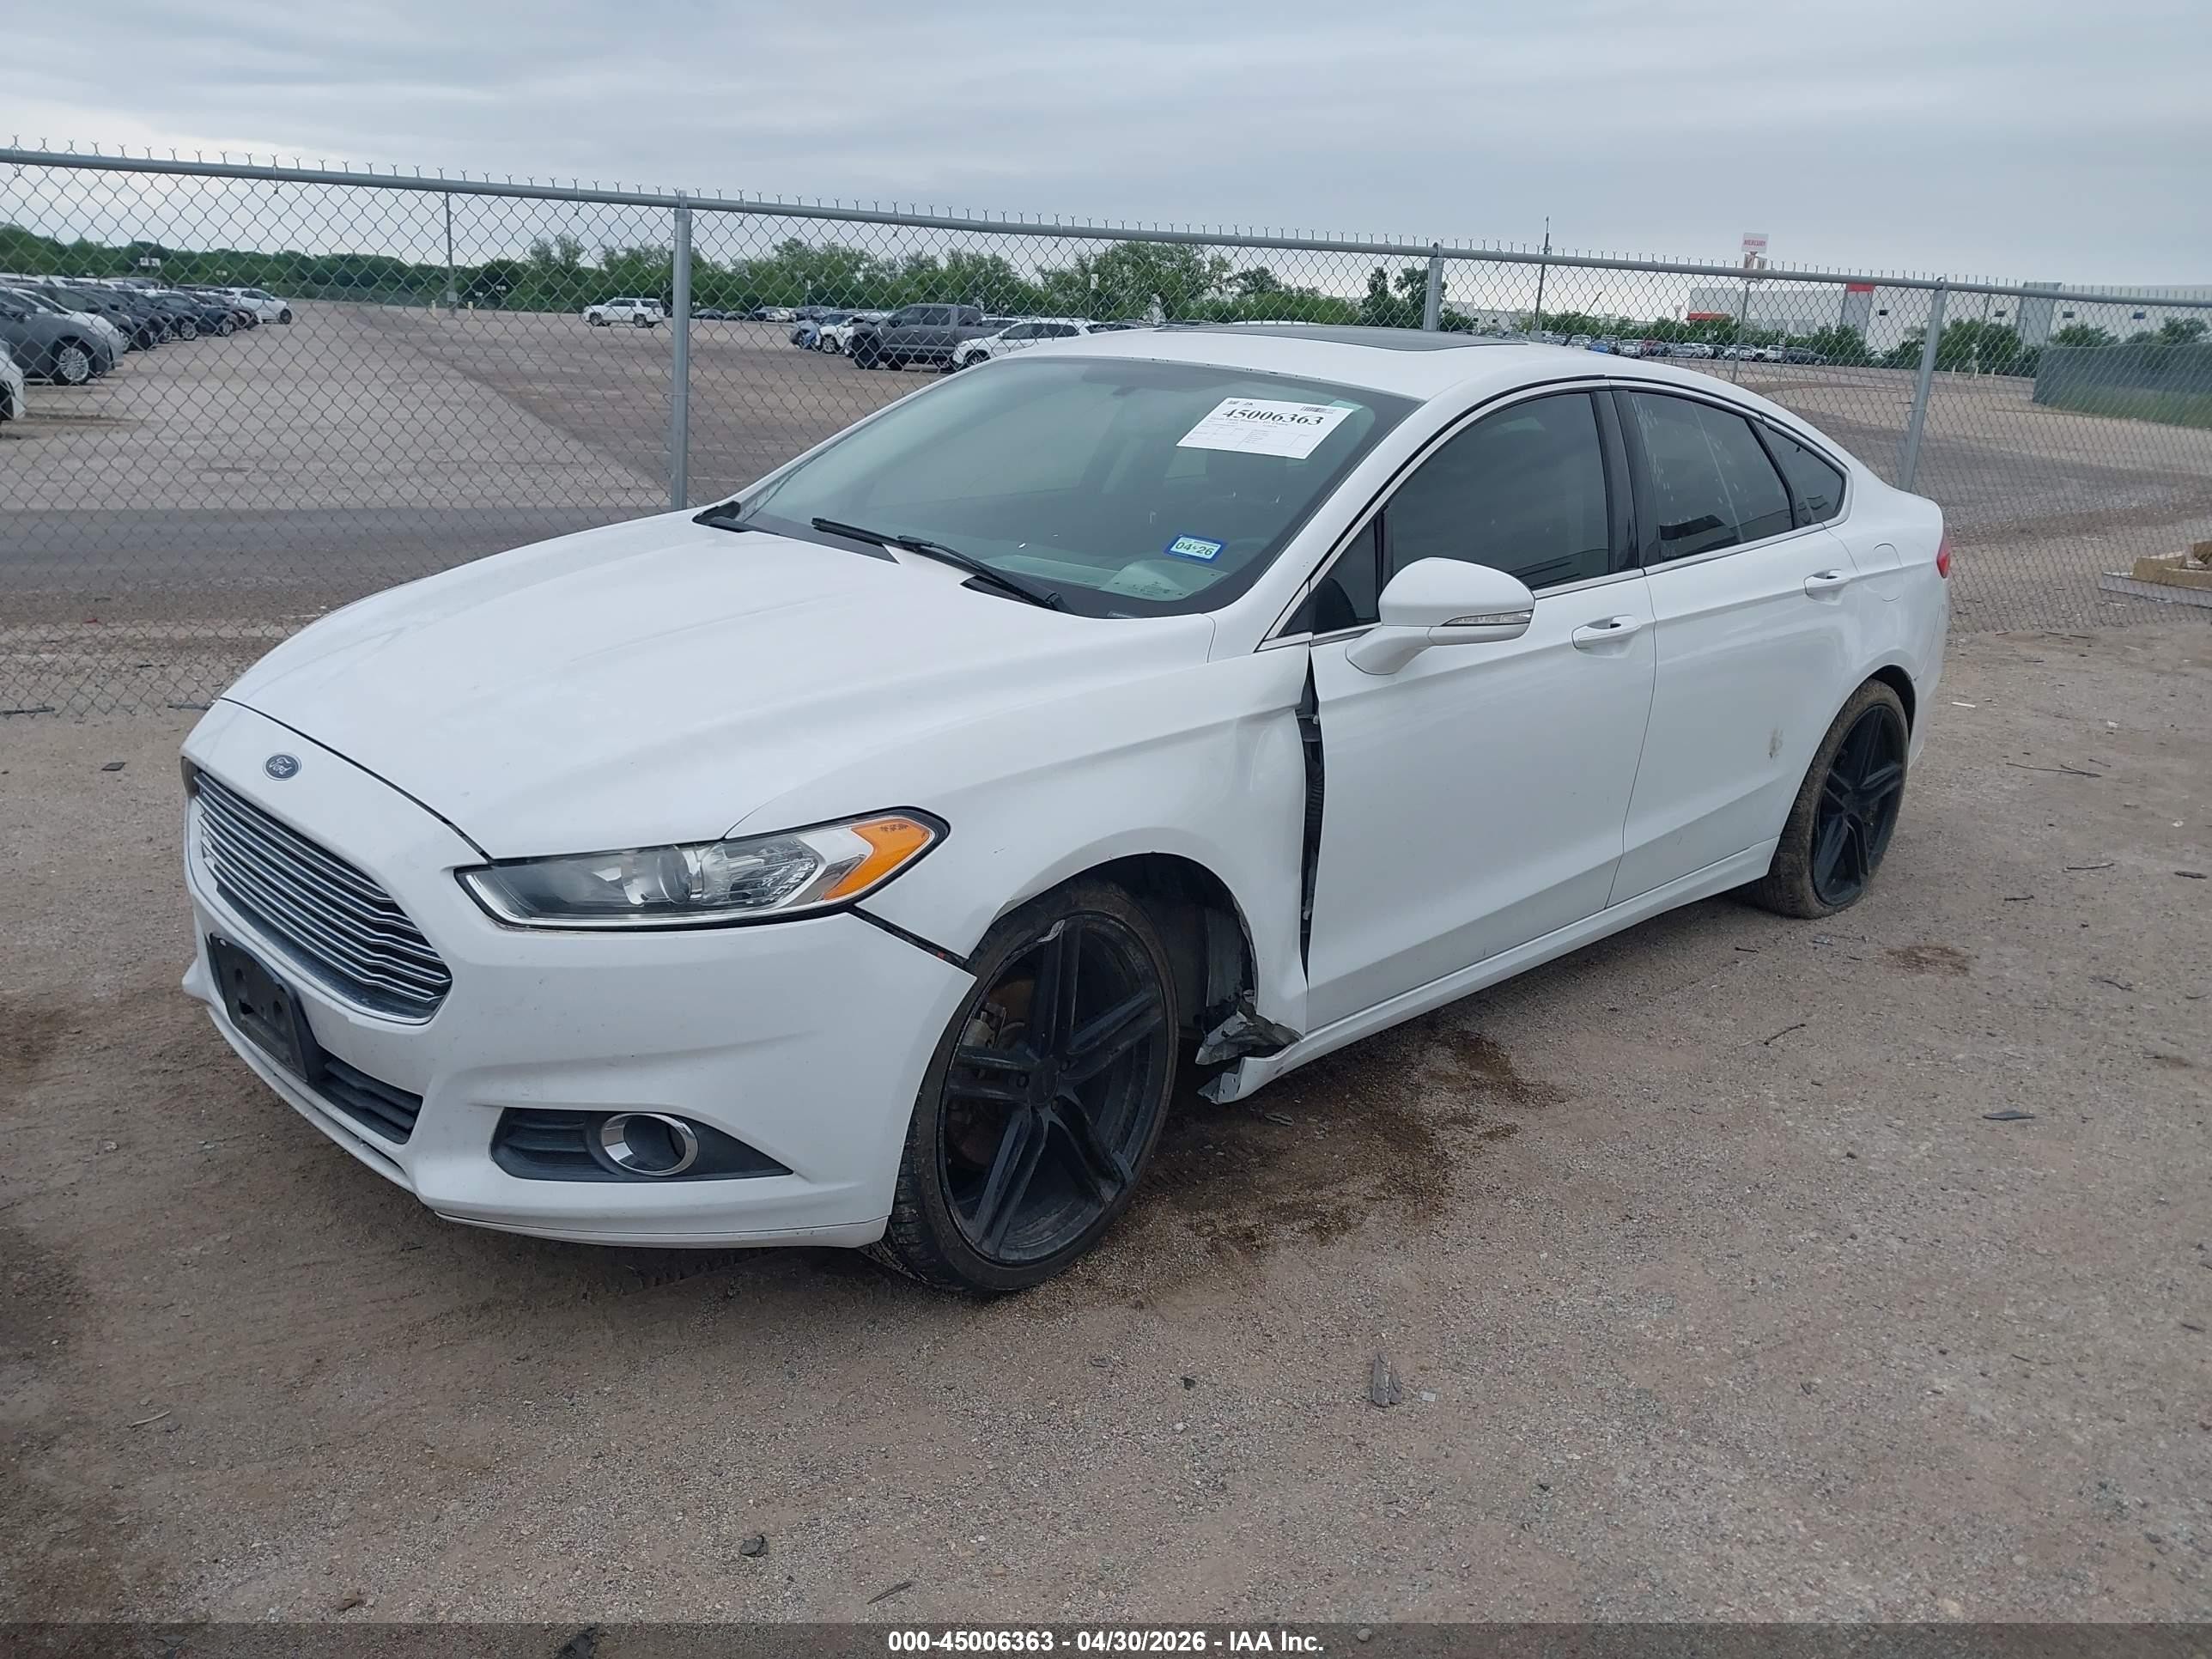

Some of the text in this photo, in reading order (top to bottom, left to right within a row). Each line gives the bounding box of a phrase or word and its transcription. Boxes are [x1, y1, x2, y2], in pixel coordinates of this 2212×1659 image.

[1223, 408, 1324, 426] 45006363
[1175, 542, 1194, 550] 04
[1195, 546, 1214, 556] 26
